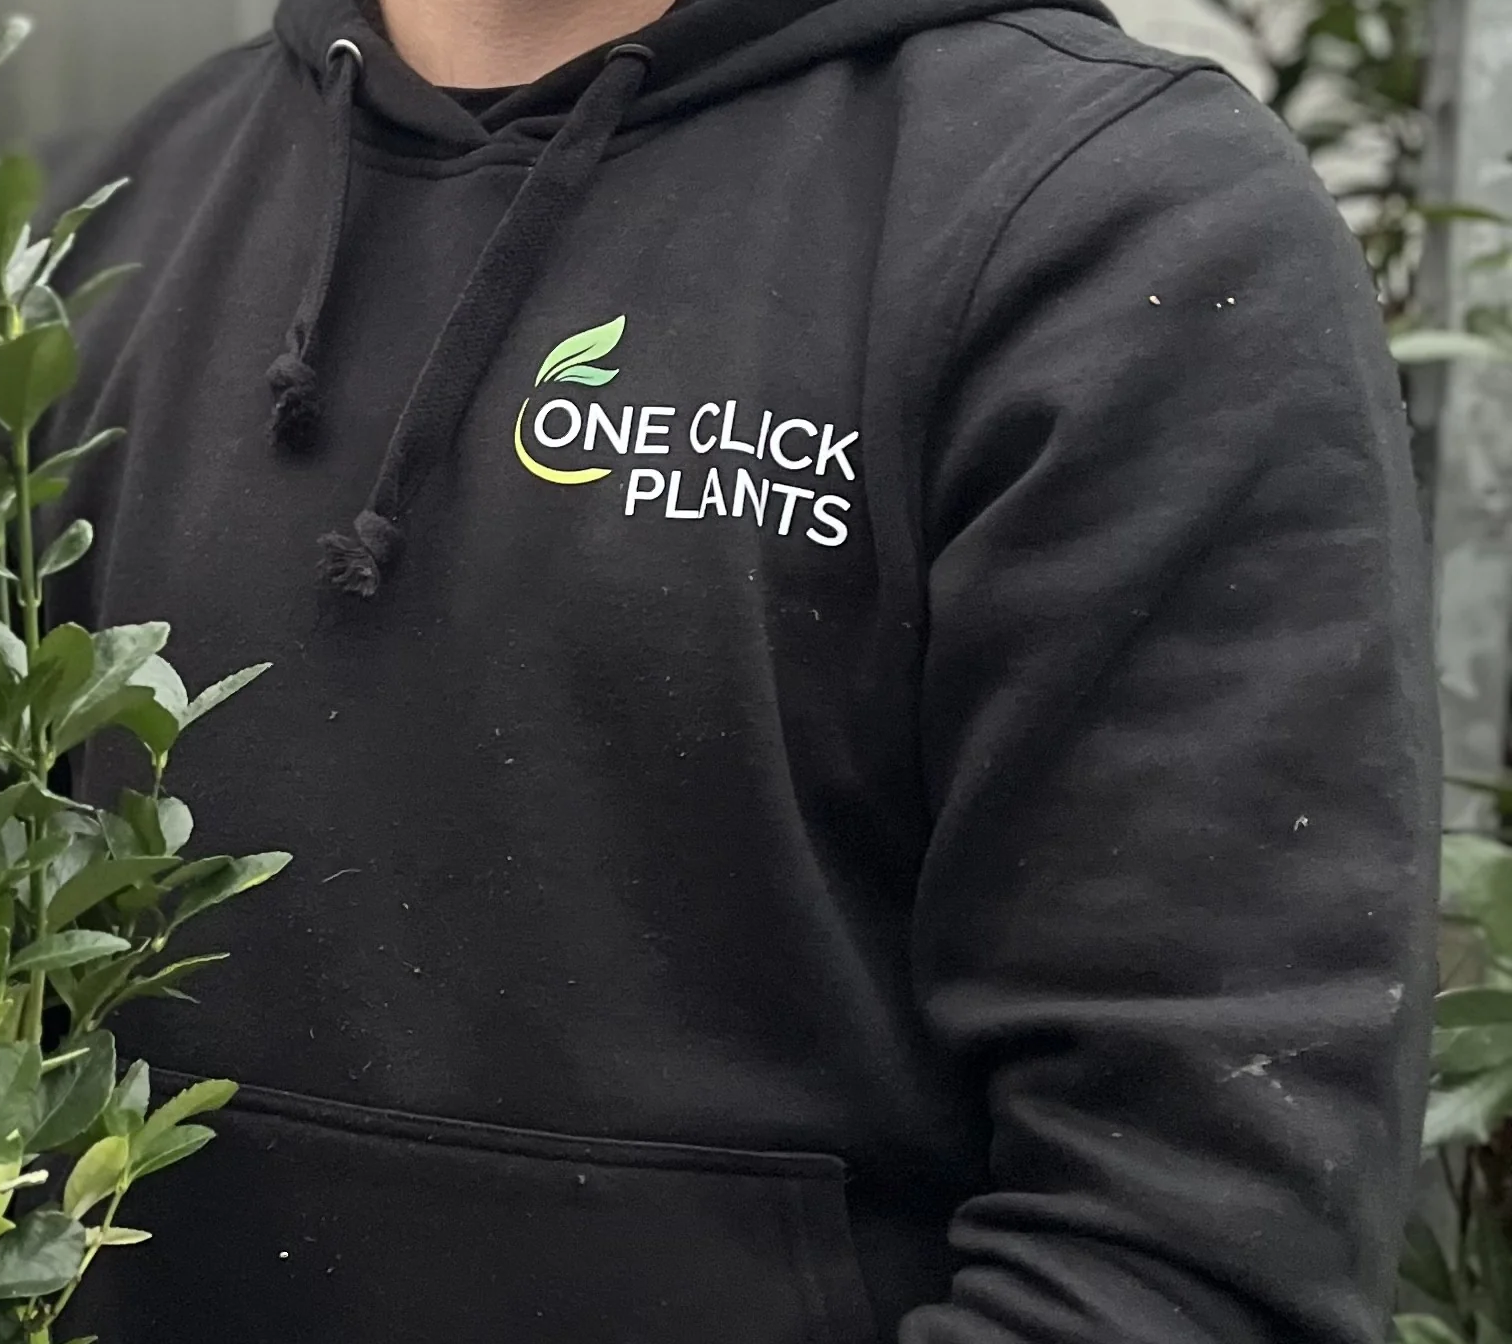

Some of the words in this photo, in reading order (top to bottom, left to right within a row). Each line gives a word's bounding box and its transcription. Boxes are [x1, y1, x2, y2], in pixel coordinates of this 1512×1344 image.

[534, 399, 675, 455] ONE
[690, 400, 859, 481] CLICK
[625, 468, 851, 547] PLANTS
